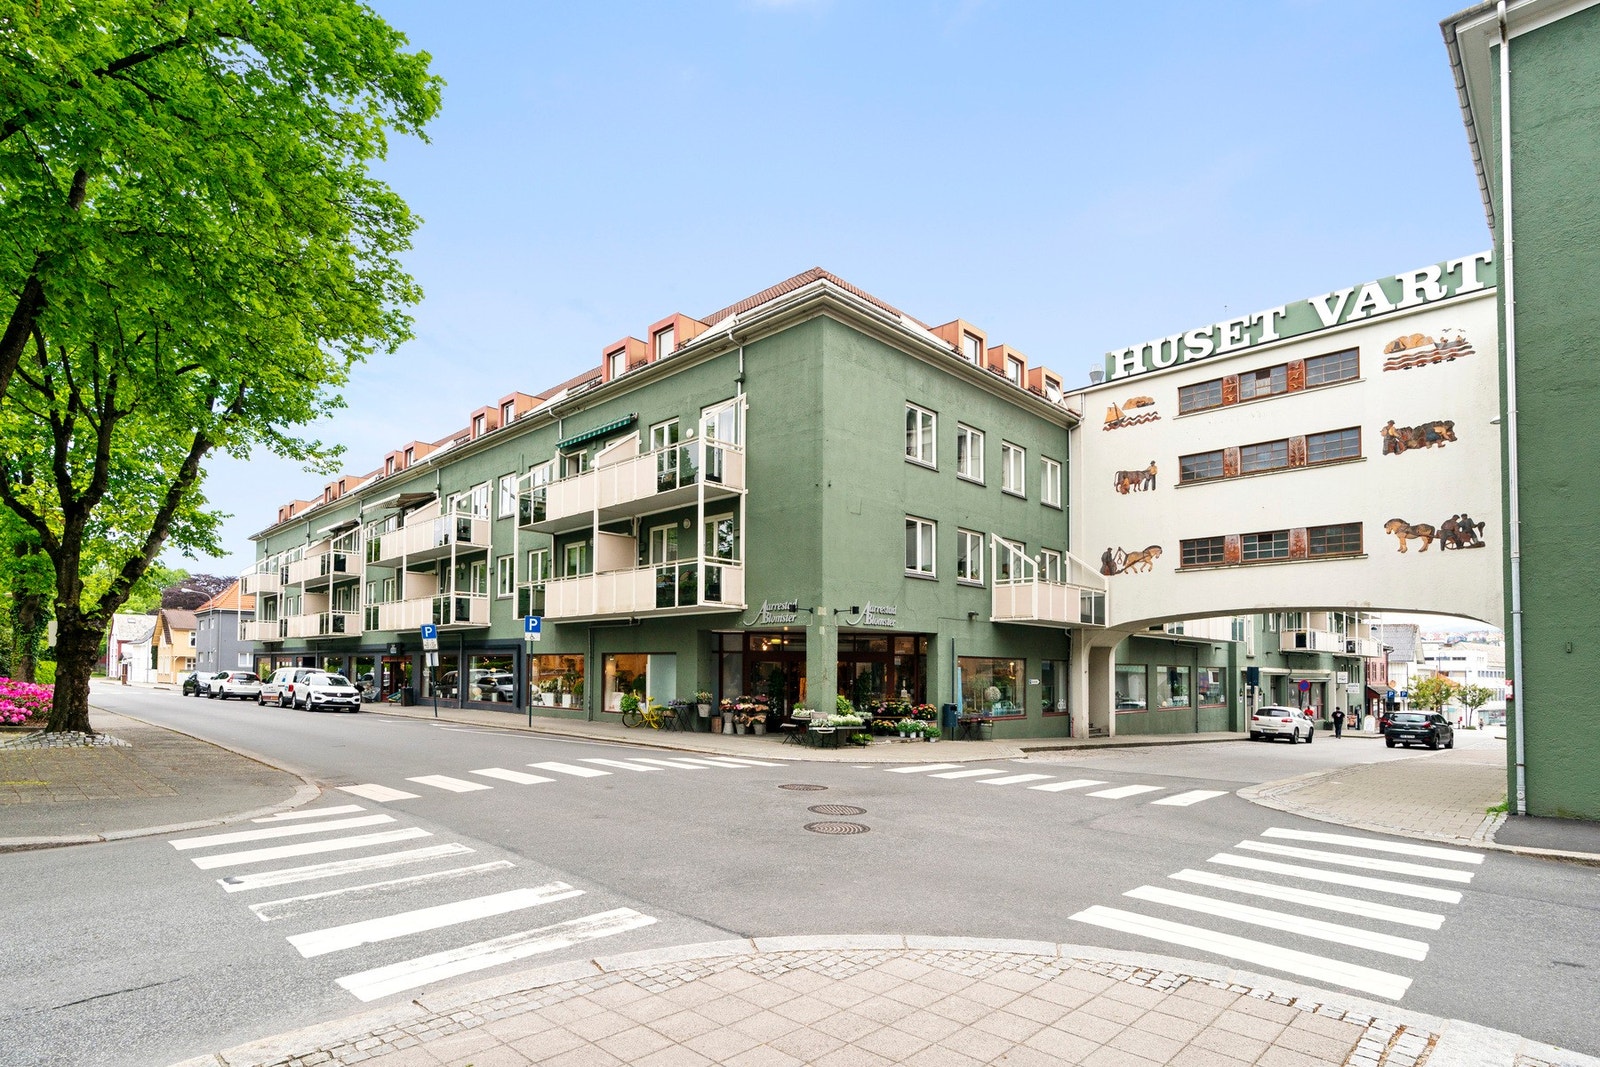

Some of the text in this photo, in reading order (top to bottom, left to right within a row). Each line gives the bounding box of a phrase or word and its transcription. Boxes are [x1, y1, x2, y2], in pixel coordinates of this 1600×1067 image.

[1111, 305, 1286, 379] HUSET
[529, 617, 538, 631] P
[762, 613, 797, 624] Blomster
[865, 613, 896, 626] Blomster
[424, 626, 433, 637] P
